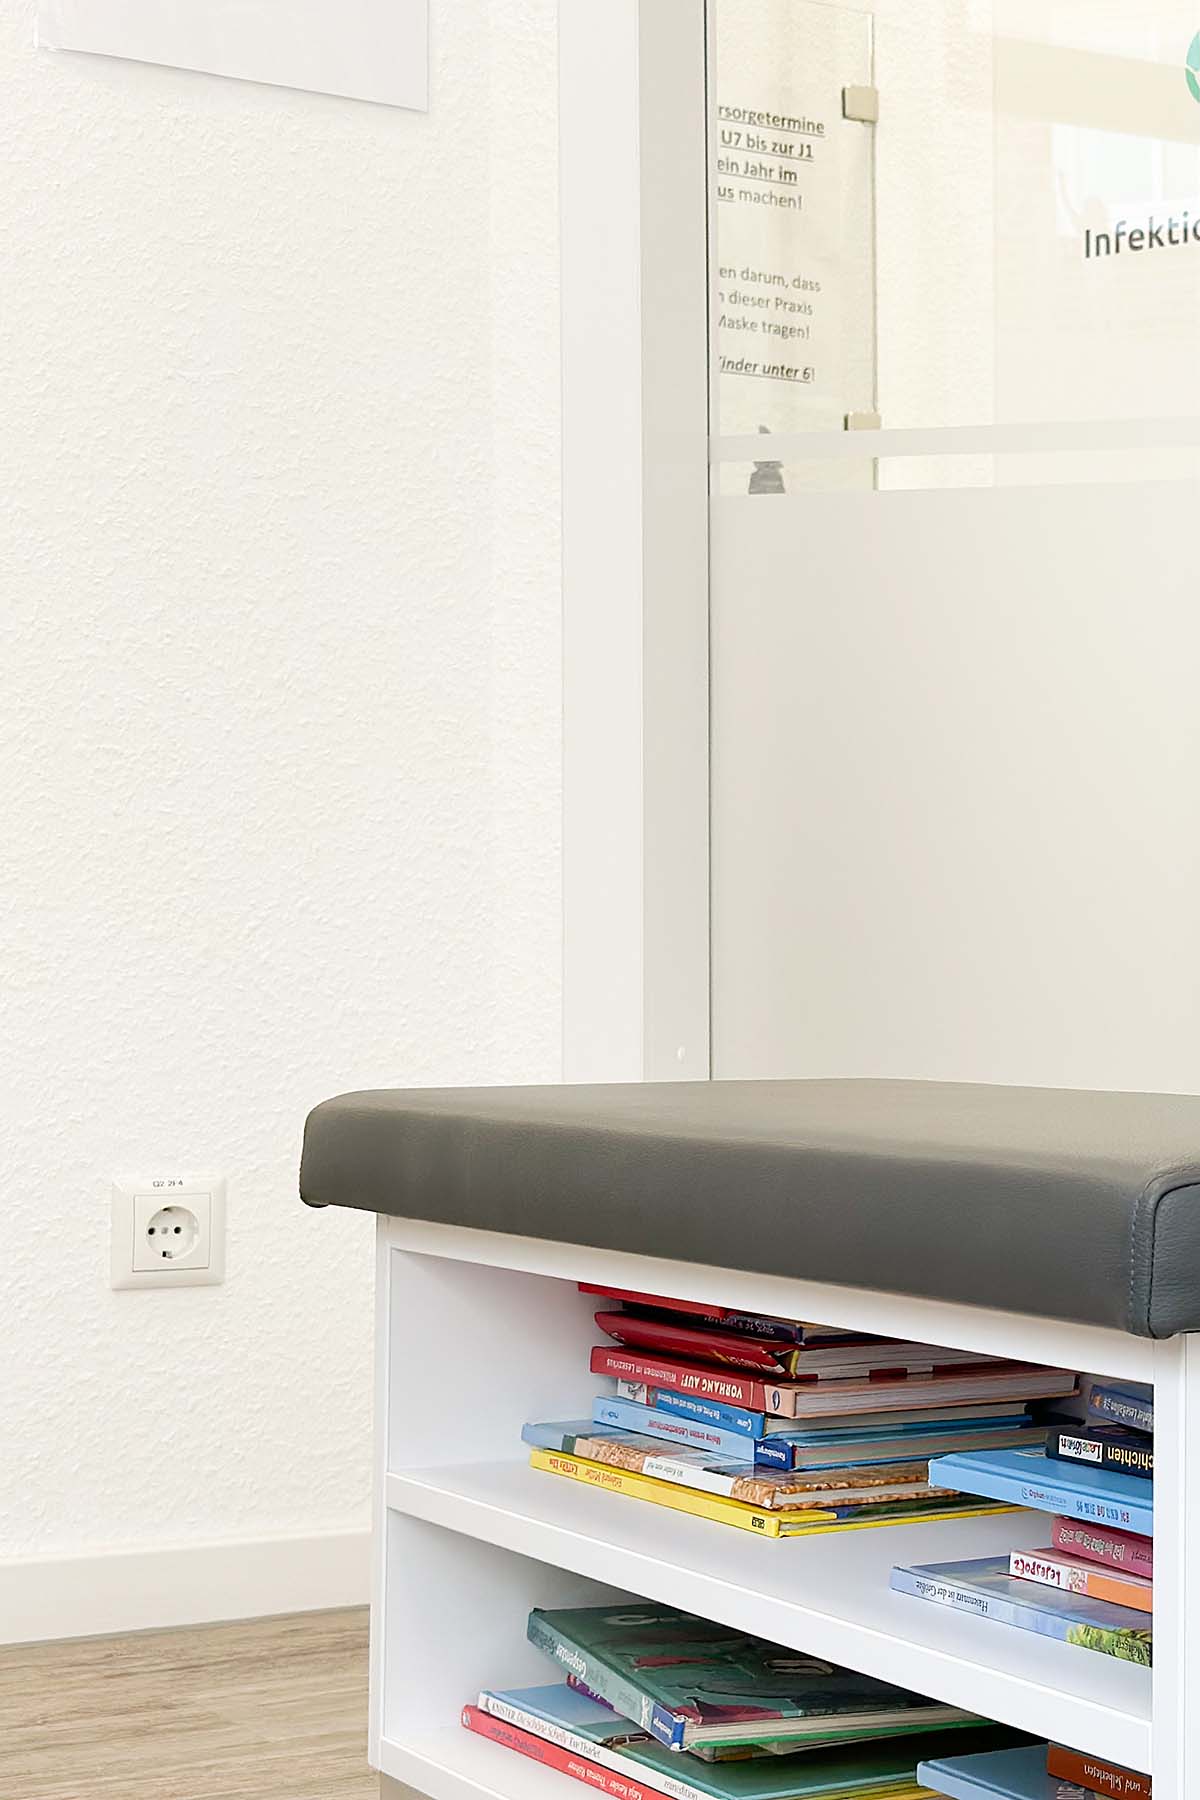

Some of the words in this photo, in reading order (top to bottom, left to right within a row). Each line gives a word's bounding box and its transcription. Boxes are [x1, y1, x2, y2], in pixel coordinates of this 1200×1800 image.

[721, 129, 742, 147] U7
[746, 133, 768, 151] bis
[771, 141, 794, 156] zur
[798, 143, 814, 159] J1
[717, 156, 740, 174] ein
[743, 160, 775, 179] Jahr
[778, 165, 798, 183] im
[739, 190, 803, 210] machen!
[740, 266, 790, 289] darum,
[791, 275, 822, 293] dass
[728, 290, 770, 309] dieser
[775, 297, 815, 317] Praxis
[761, 320, 811, 341] tragen!
[719, 355, 758, 373] inder
[762, 364, 800, 379] unter
[680, 1372, 700, 1388] AUF!
[701, 1375, 743, 1400] VORHANG
